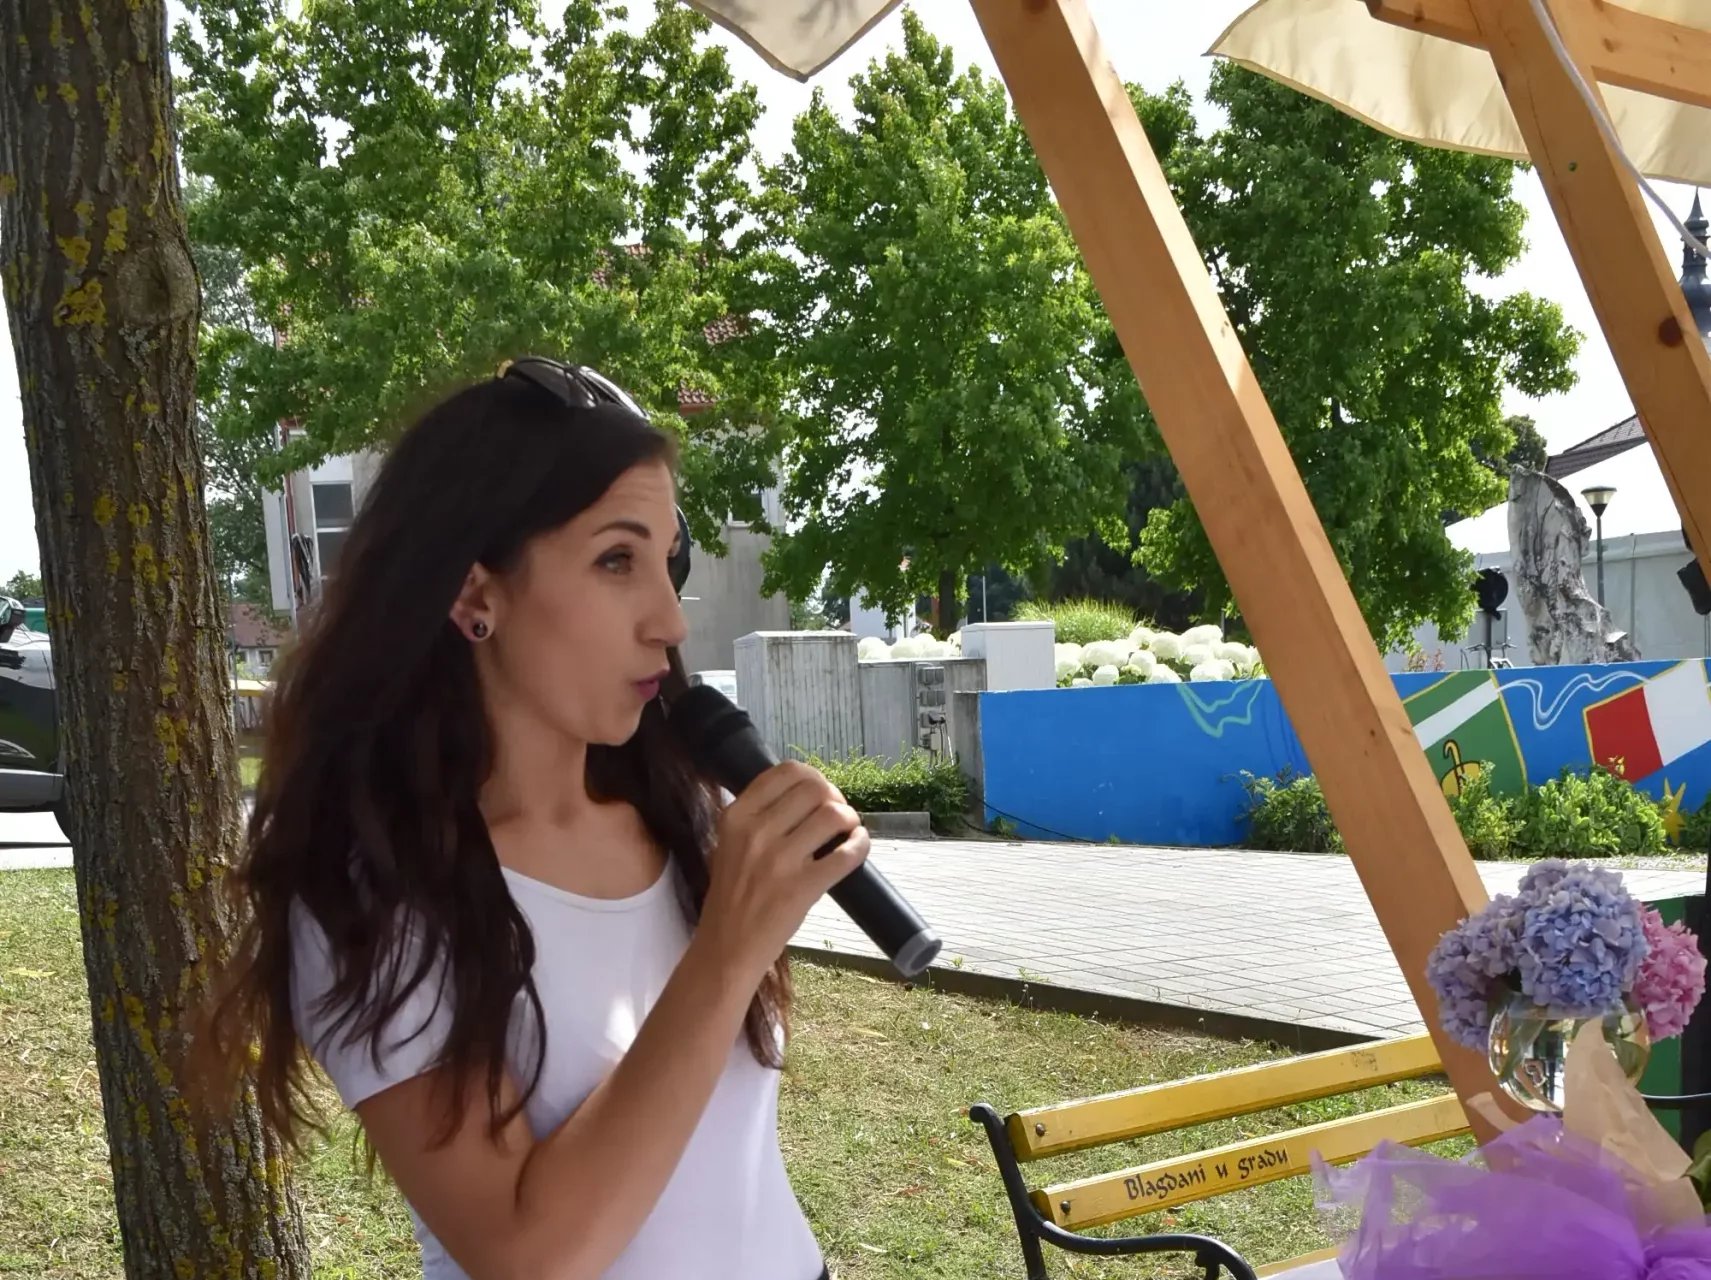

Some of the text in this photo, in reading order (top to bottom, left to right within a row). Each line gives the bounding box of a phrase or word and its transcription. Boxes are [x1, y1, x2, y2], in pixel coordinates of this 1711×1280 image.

[1123, 1148, 1288, 1200] Blagdani u gradu
